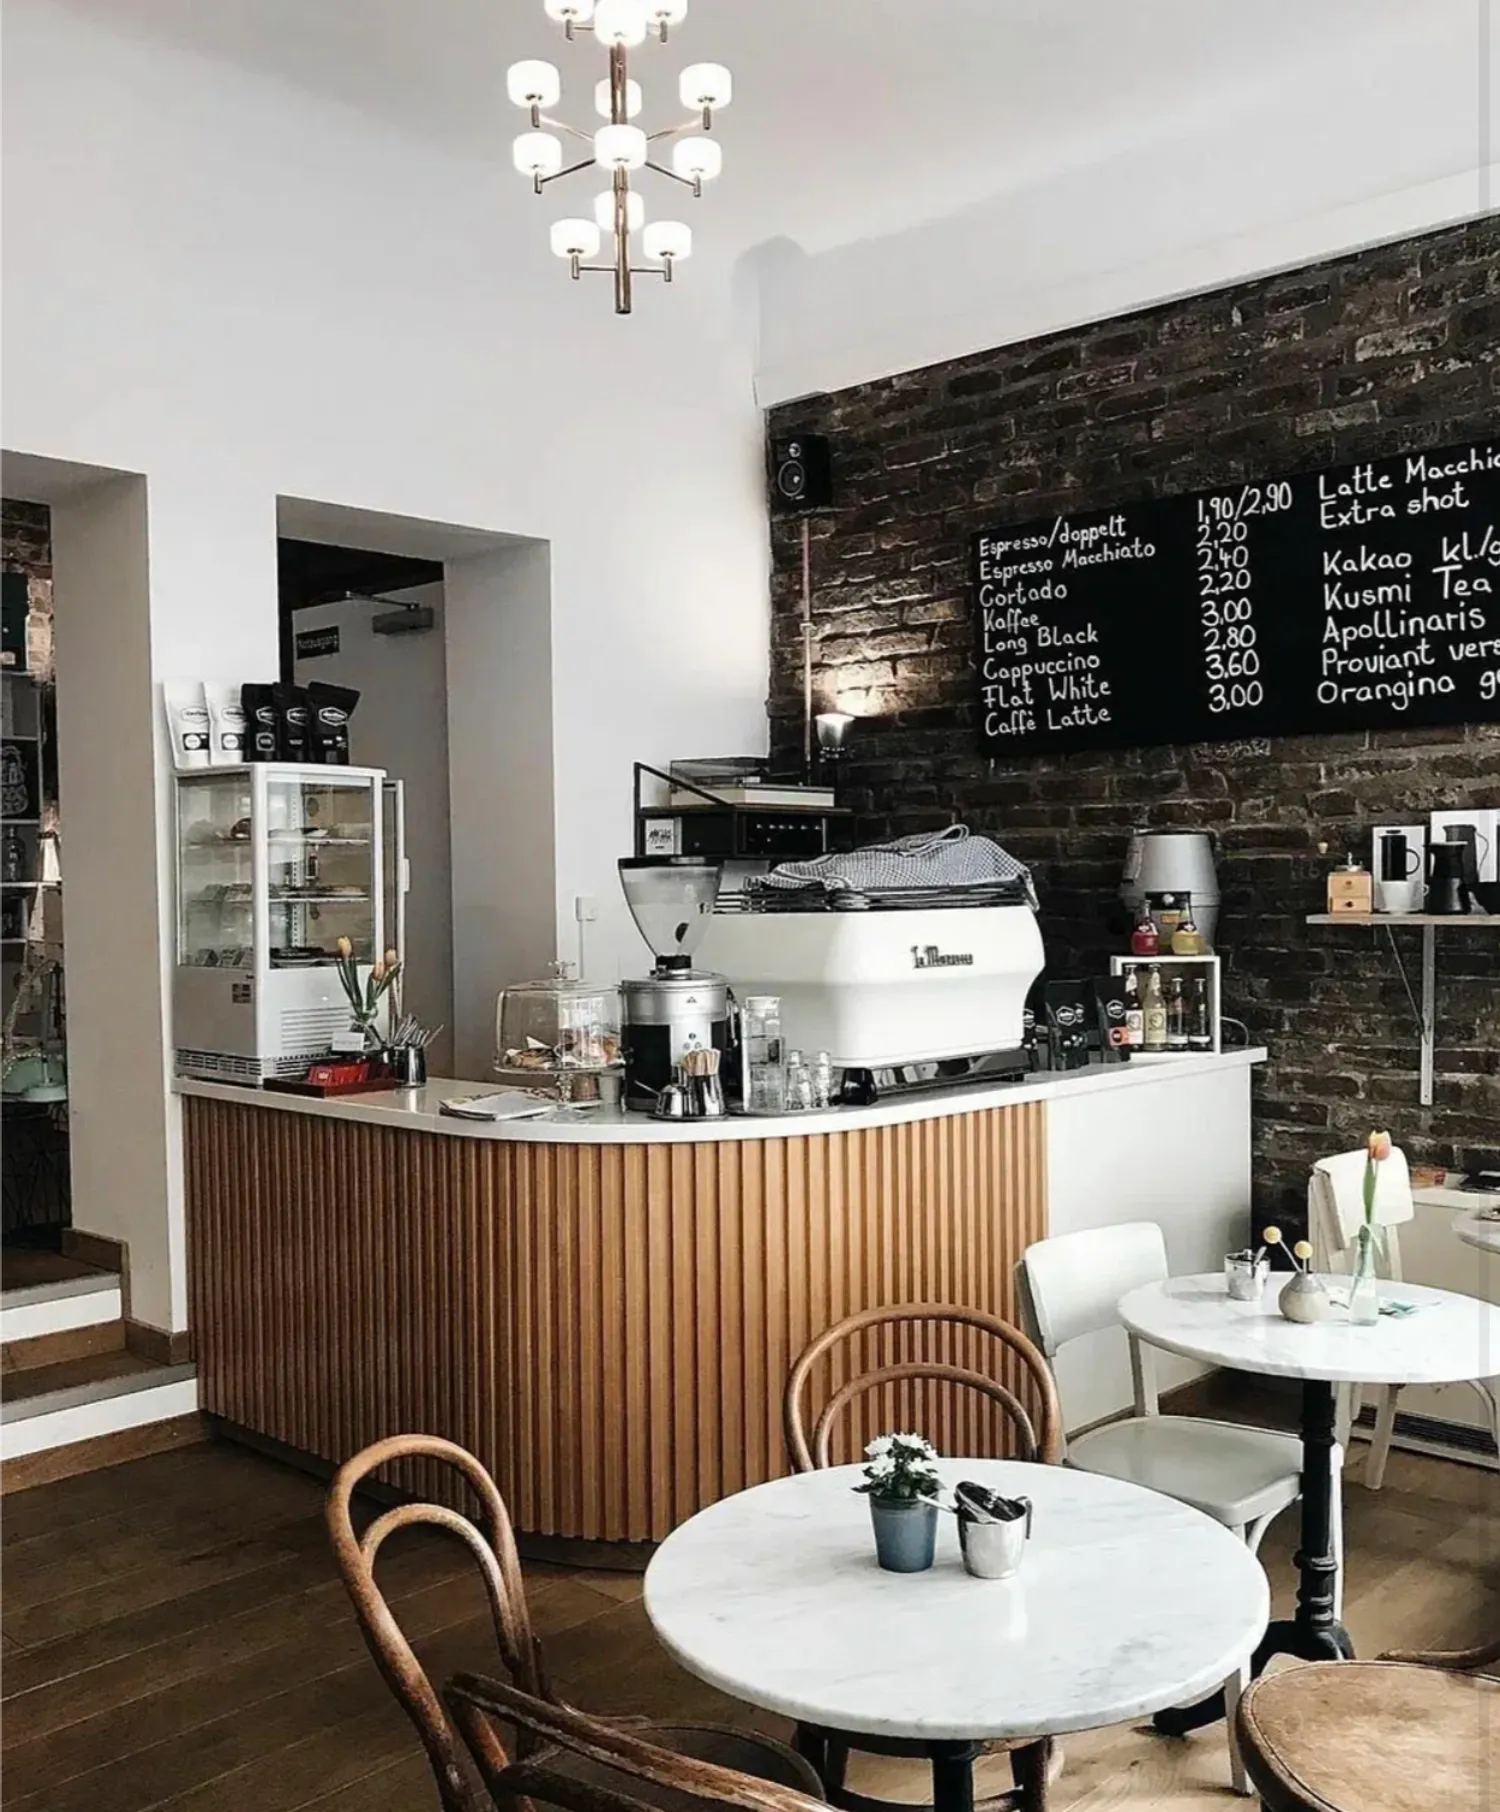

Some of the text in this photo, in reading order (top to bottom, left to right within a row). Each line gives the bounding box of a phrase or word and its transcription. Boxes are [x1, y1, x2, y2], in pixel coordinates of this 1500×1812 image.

[1318, 463, 1393, 501] Latte
[1197, 481, 1293, 525] 1,90/2,90
[1319, 480, 1471, 531] Extra shot
[979, 514, 1127, 561] Espresso/doppelt
[1196, 520, 1249, 550] 2,20
[979, 536, 1157, 588] Espresso Macchiato
[1197, 545, 1250, 573] 2,40
[1322, 544, 1413, 577] Kakao
[978, 578, 1069, 609] Cortado
[1199, 568, 1252, 597] 2,20
[1322, 562, 1493, 612] Kusmi Tea
[982, 607, 1041, 635] Kaffee
[1200, 596, 1253, 628] 3,00
[1322, 600, 1487, 652] Apollinaris
[983, 621, 1100, 657] Long Black
[1203, 624, 1257, 653] 2,80
[1321, 636, 1436, 677] Proviant
[982, 651, 1101, 689] Cappuccino
[1204, 648, 1261, 681] 3,60
[980, 672, 1112, 710] Flat White
[1207, 680, 1264, 714] 3,00
[1316, 670, 1457, 711] Orangina
[1046, 702, 1112, 731] Latte
